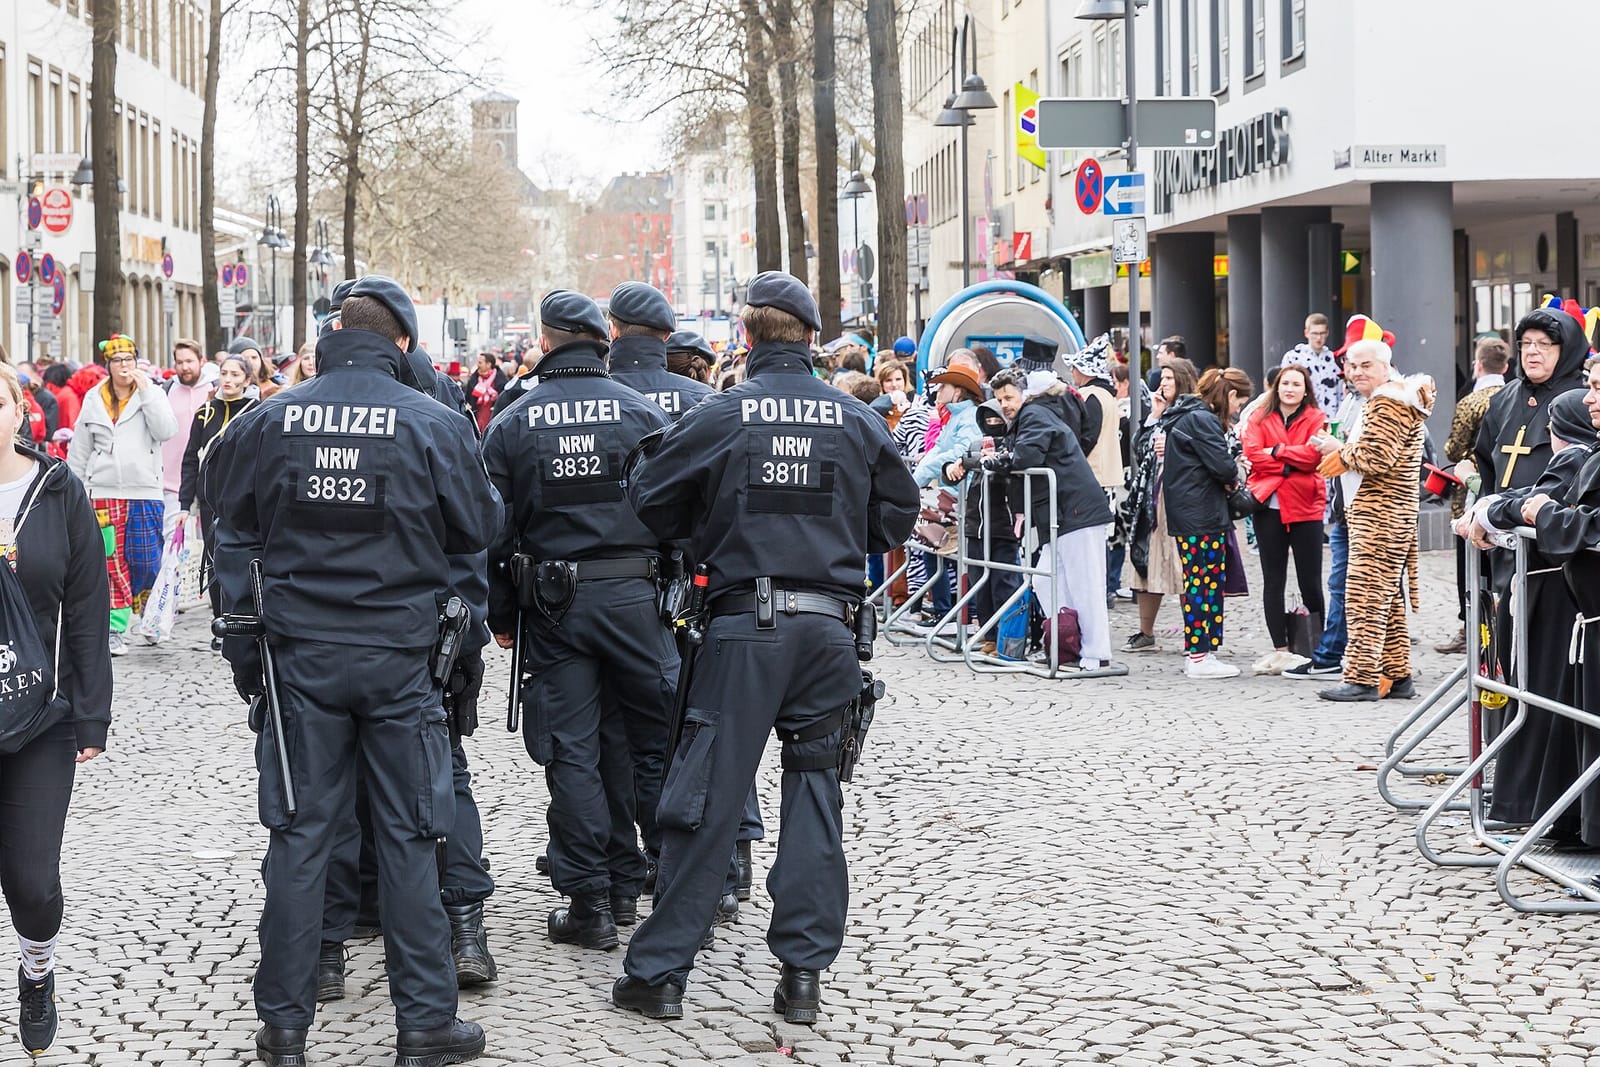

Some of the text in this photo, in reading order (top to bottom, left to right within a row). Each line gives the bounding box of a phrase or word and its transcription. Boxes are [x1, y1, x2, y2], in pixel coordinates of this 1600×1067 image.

[1226, 107, 1288, 183] HOTELS
[1363, 149, 1437, 163] Alter Markt
[528, 399, 621, 427] POLIZEI
[645, 391, 680, 413] ZEI
[741, 398, 843, 425] POLIZEI
[283, 404, 397, 435] POLIZEI
[558, 434, 595, 454] NRW
[772, 436, 812, 457] NRW
[315, 447, 360, 470] NRW
[552, 455, 601, 478] 3832
[761, 461, 808, 485] 3811
[306, 475, 367, 502] 3832
[157, 583, 170, 612] ACTION
[0, 668, 43, 694] KEN
